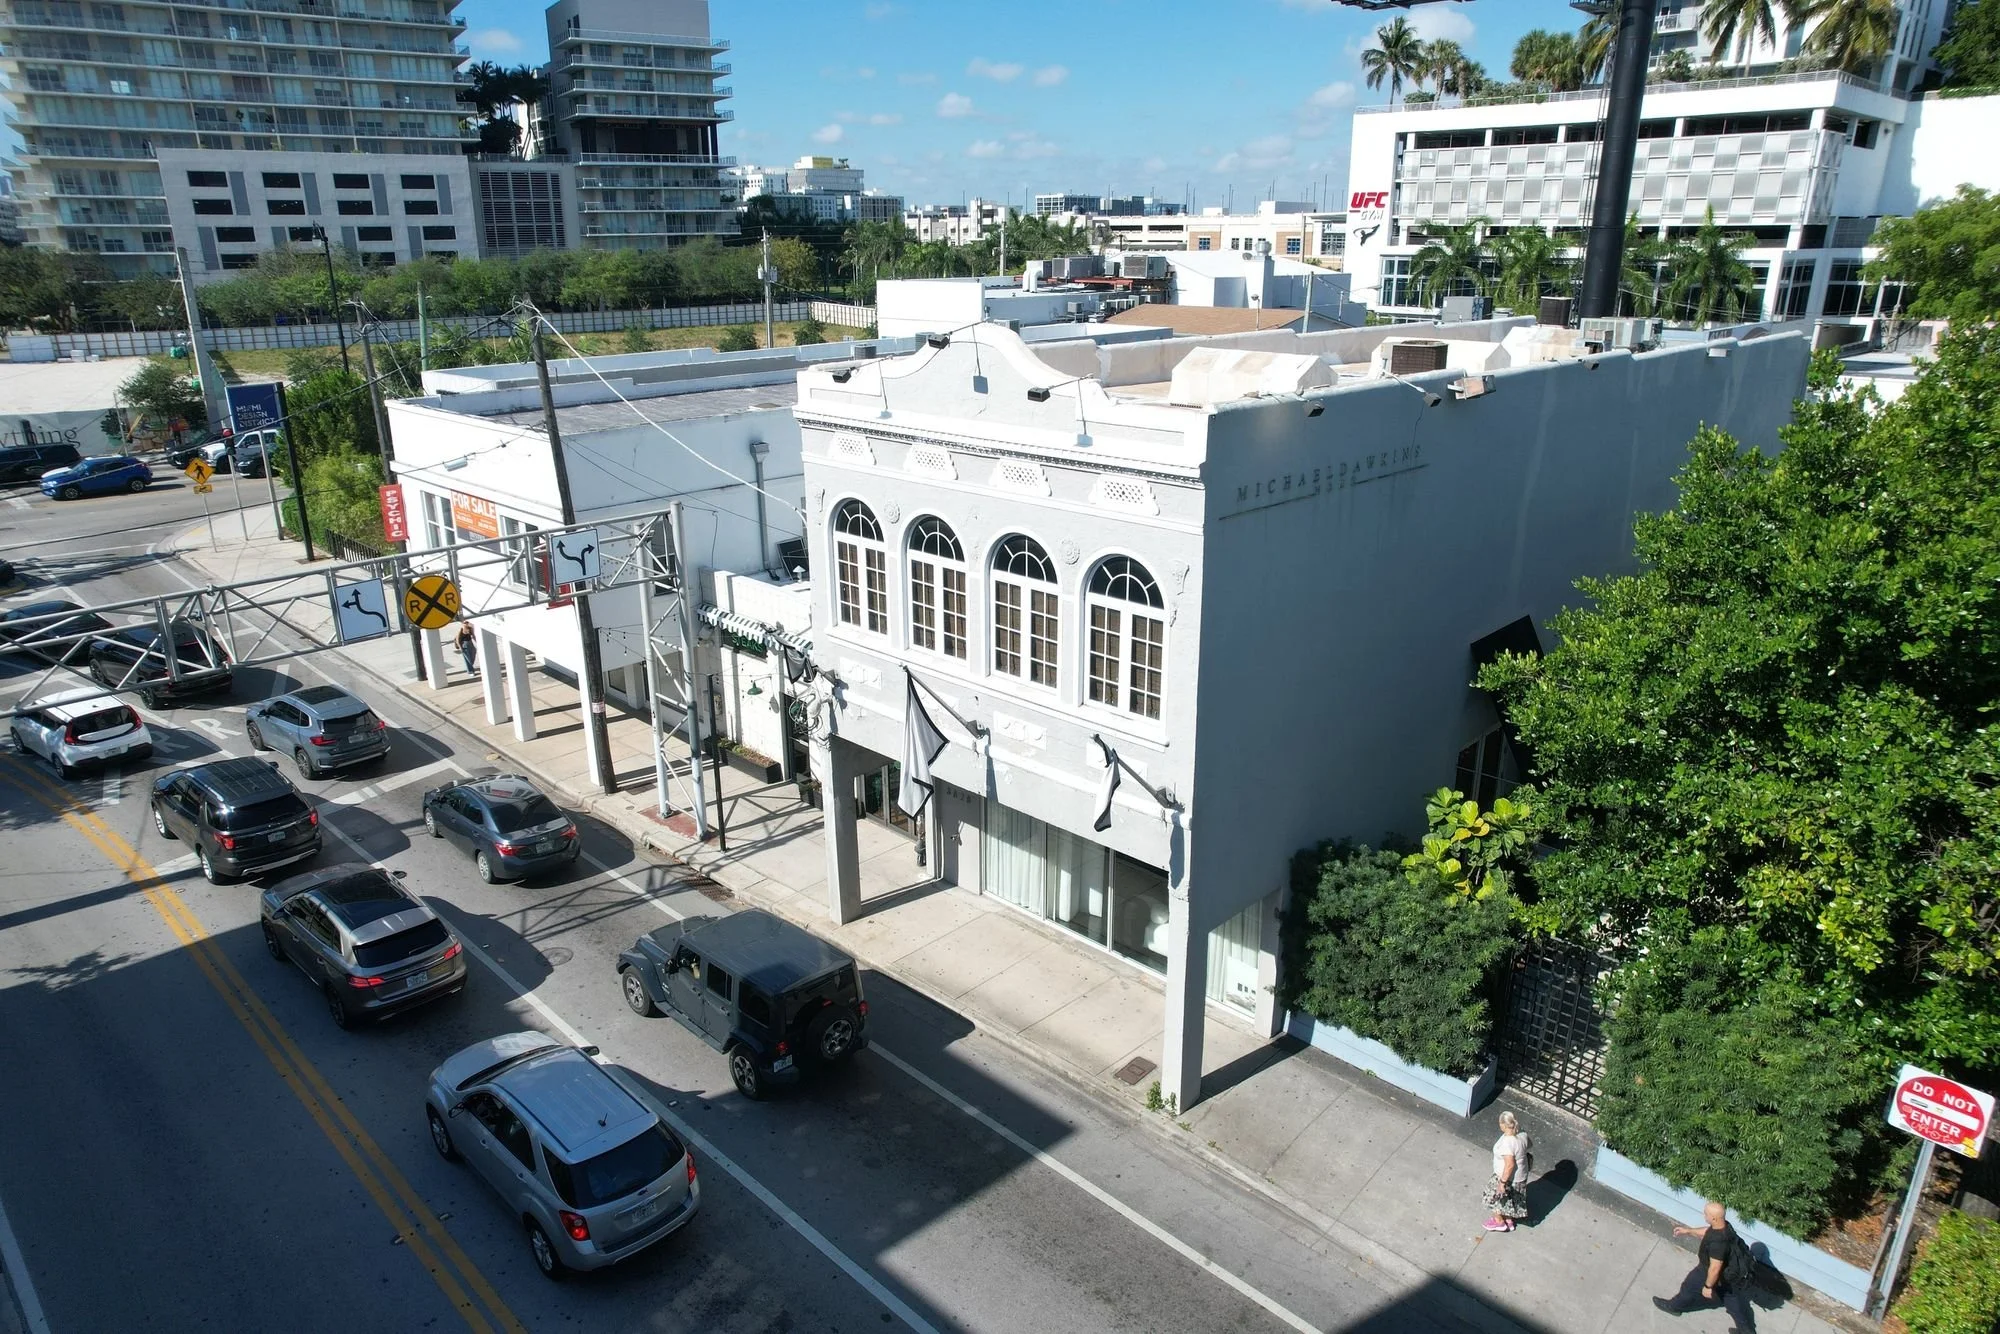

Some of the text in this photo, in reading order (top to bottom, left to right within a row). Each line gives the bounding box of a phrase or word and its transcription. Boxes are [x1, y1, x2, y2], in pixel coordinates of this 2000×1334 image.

[1351, 192, 1389, 208] UFC
[1361, 210, 1385, 220] GYM
[386, 490, 403, 537] PSYCHIC
[452, 492, 471, 512] FOR
[471, 497, 496, 519] SALE
[409, 592, 456, 613] R R
[190, 718, 243, 740] R
[1912, 1081, 1935, 1097] DO
[1943, 1092, 1976, 1113] NOT
[1910, 1109, 1961, 1138] ENTER
